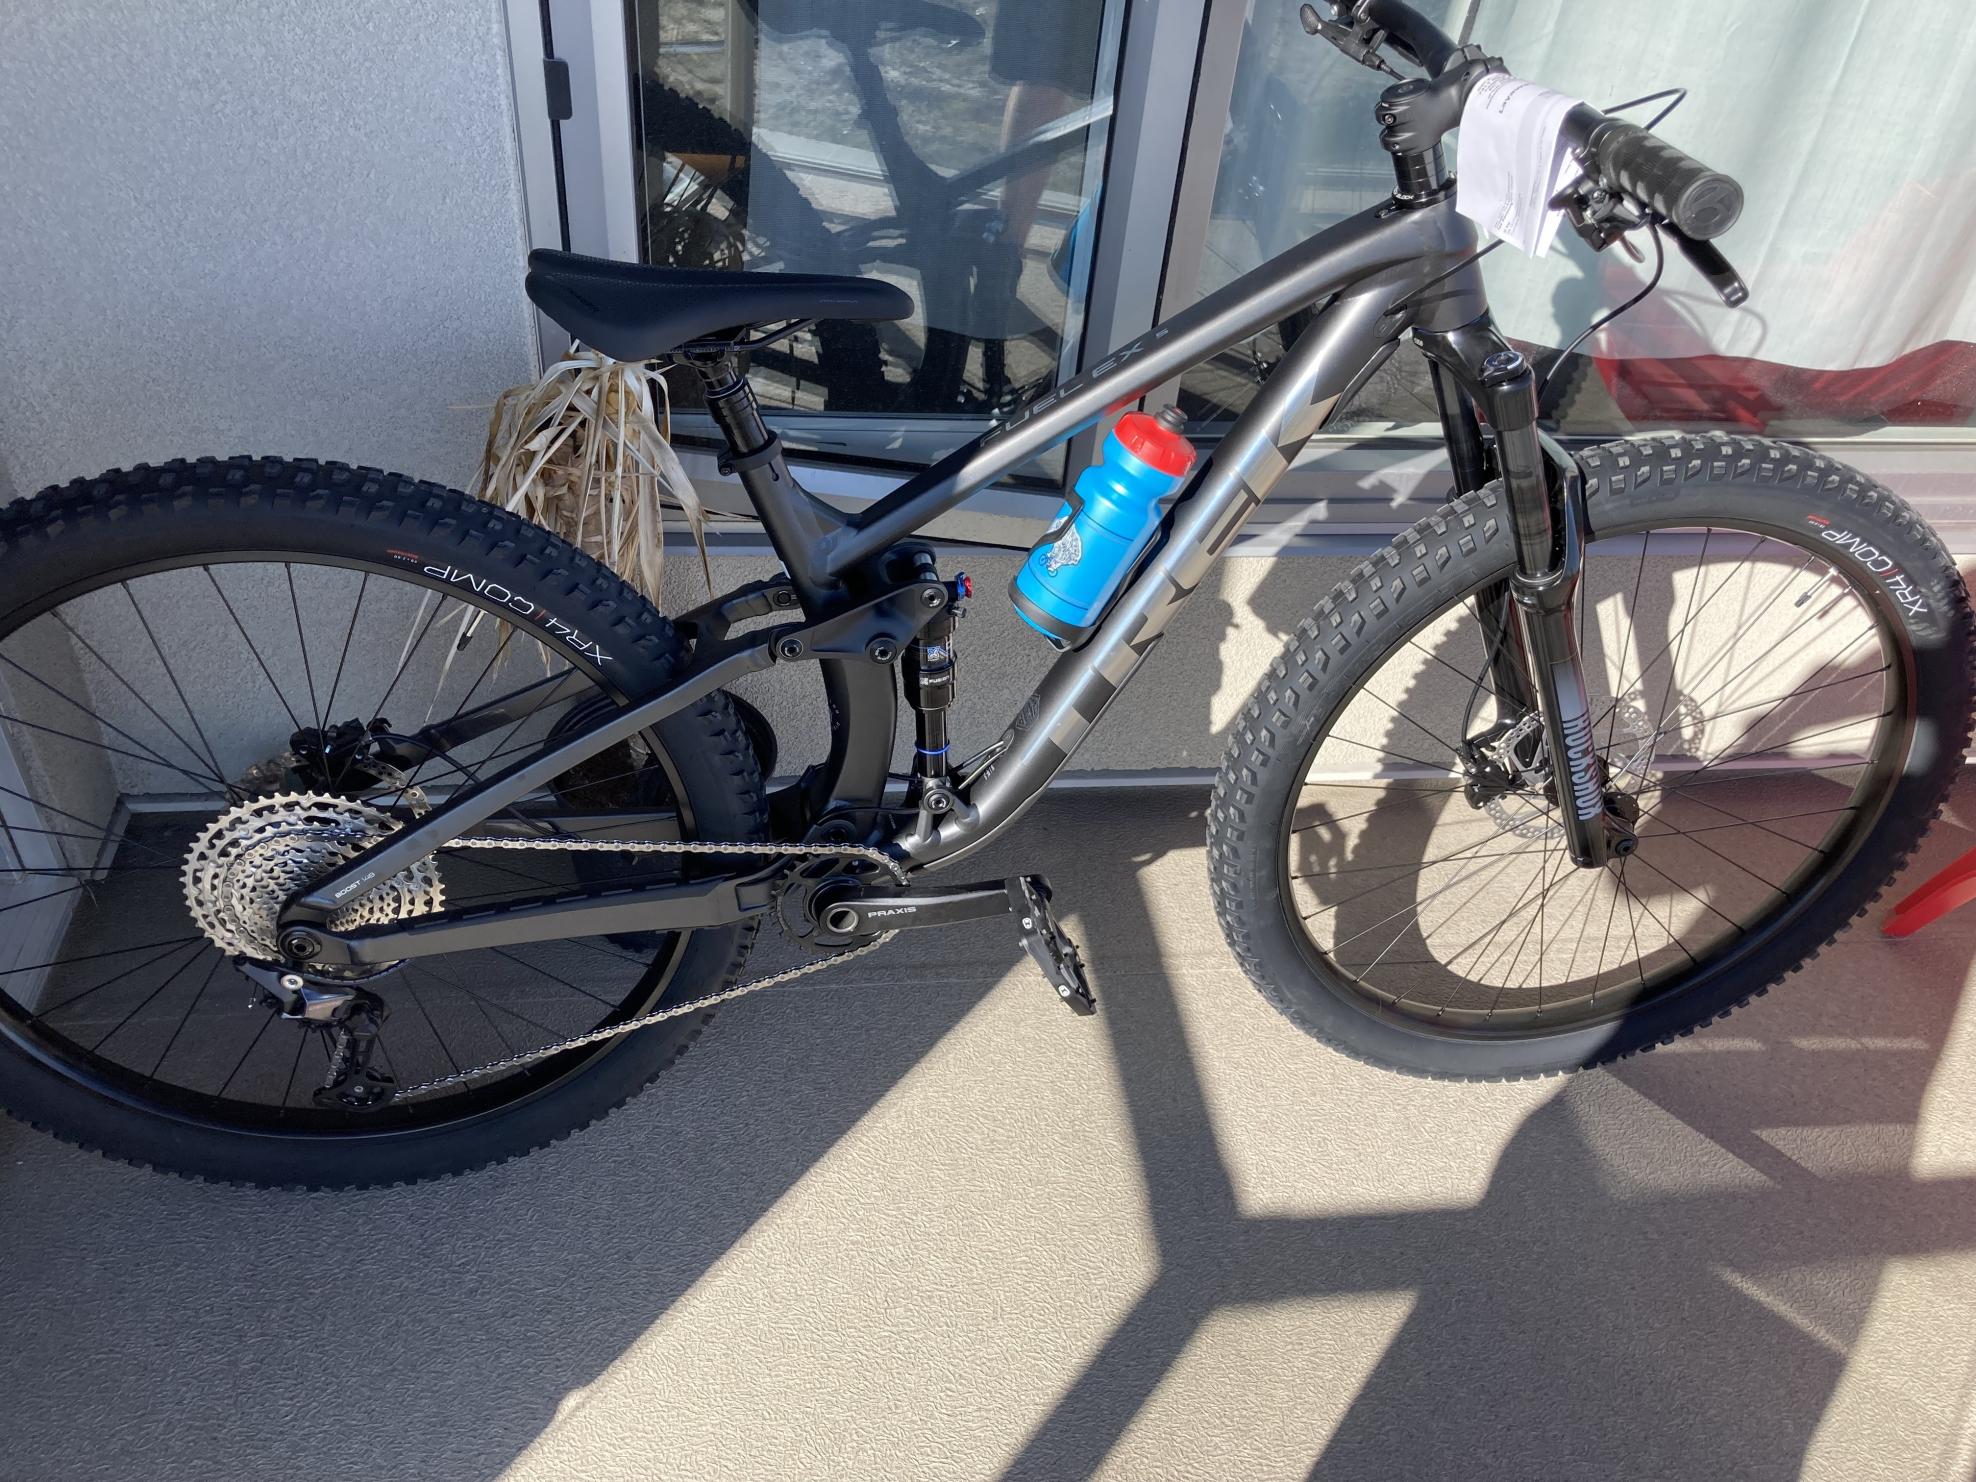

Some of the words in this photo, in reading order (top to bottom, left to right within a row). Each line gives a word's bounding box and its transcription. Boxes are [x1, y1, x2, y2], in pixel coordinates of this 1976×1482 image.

[979, 382, 1084, 448] FUEL
[1091, 340, 1145, 379] EX
[1022, 350, 1342, 764] TREK
[1820, 529, 1894, 573] COMP
[423, 564, 536, 615] COMP
[1884, 573, 1929, 617] XR4
[544, 616, 614, 666] XR4
[334, 879, 361, 899] BOOST
[867, 905, 917, 918] PRAXIS
